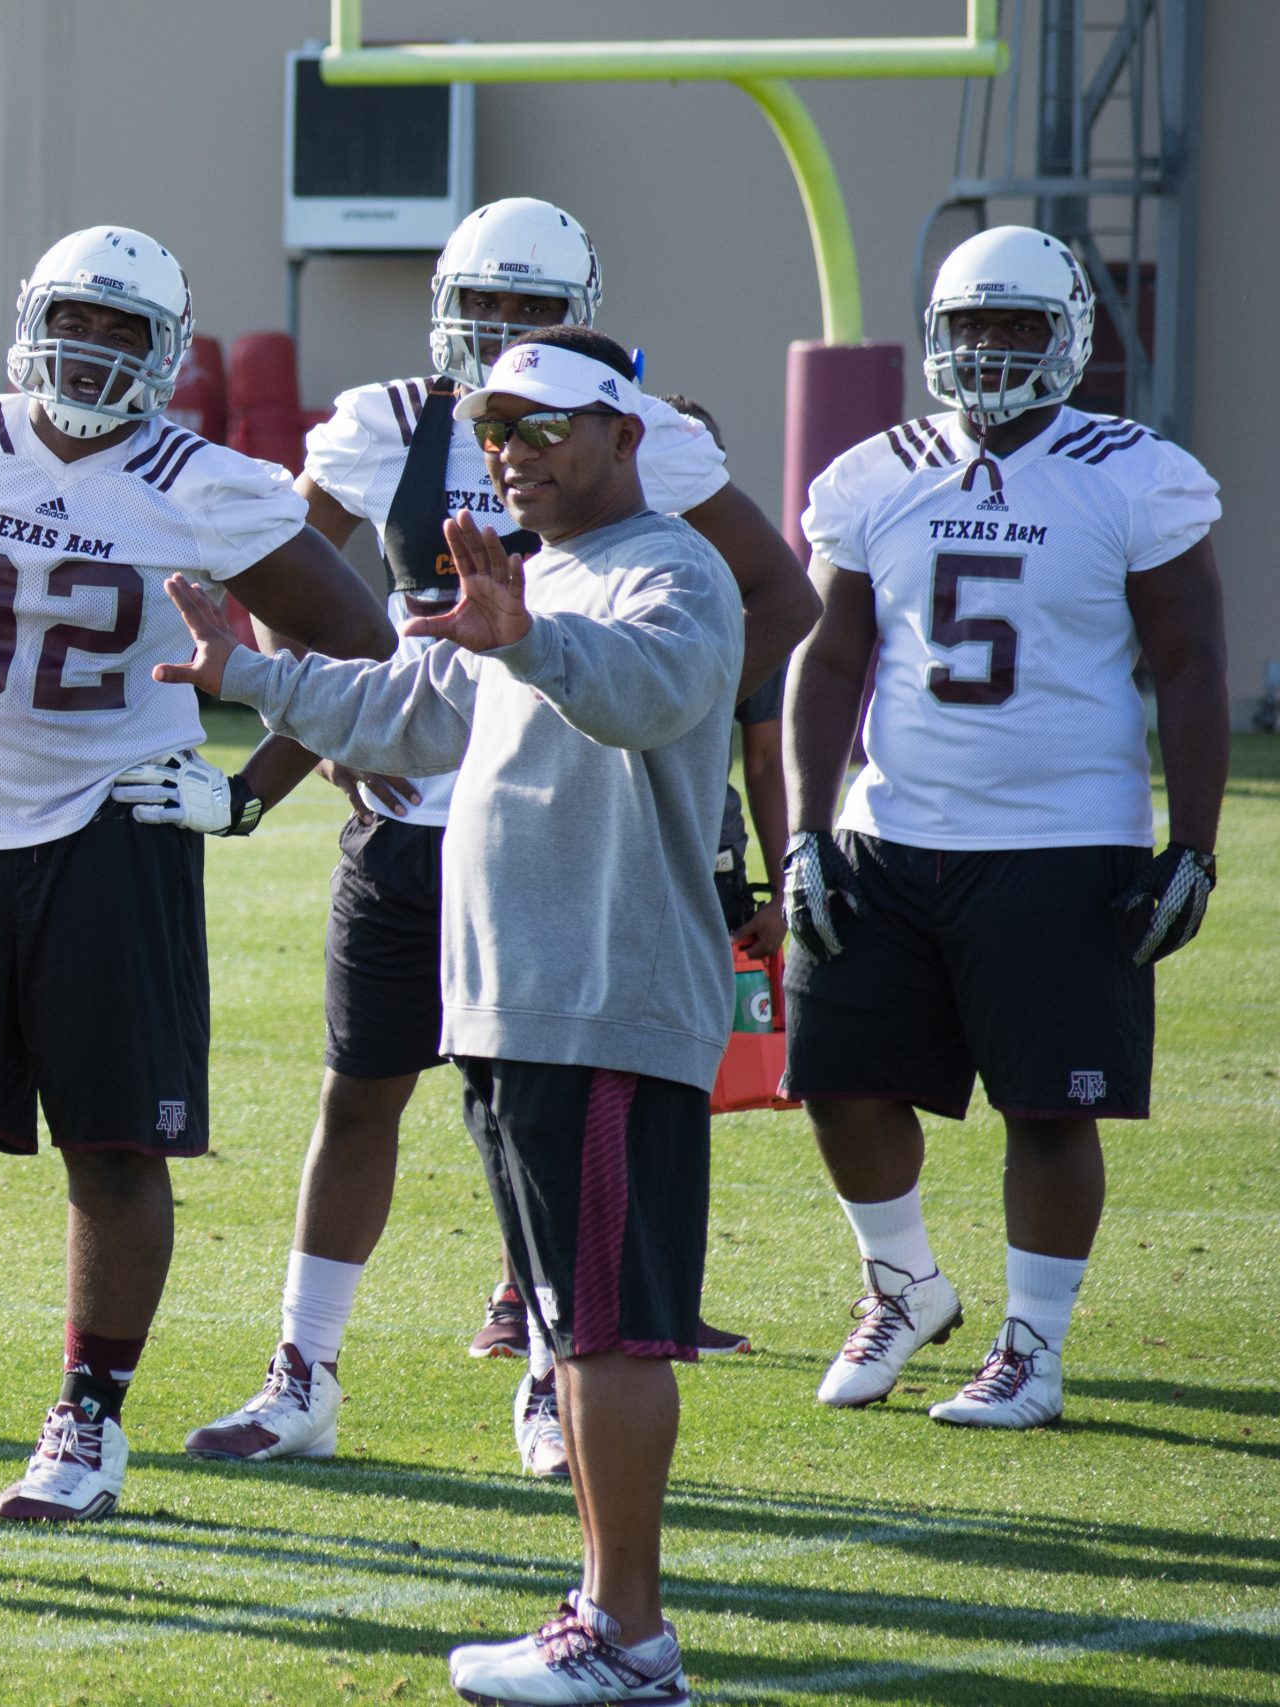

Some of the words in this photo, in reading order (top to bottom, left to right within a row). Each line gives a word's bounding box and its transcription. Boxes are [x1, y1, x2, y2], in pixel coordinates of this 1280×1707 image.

[498, 262, 530, 274] AGGIES
[91, 275, 125, 290] AGGIES
[975, 283, 1005, 293] AGGIES
[445, 490, 505, 513] EXAS
[976, 503, 1009, 512] adidas
[35, 505, 69, 521] adidas
[929, 519, 999, 541] TEXAS
[1004, 523, 1048, 546] A&M
[63, 534, 114, 559] A&M
[925, 550, 1027, 709] 5
